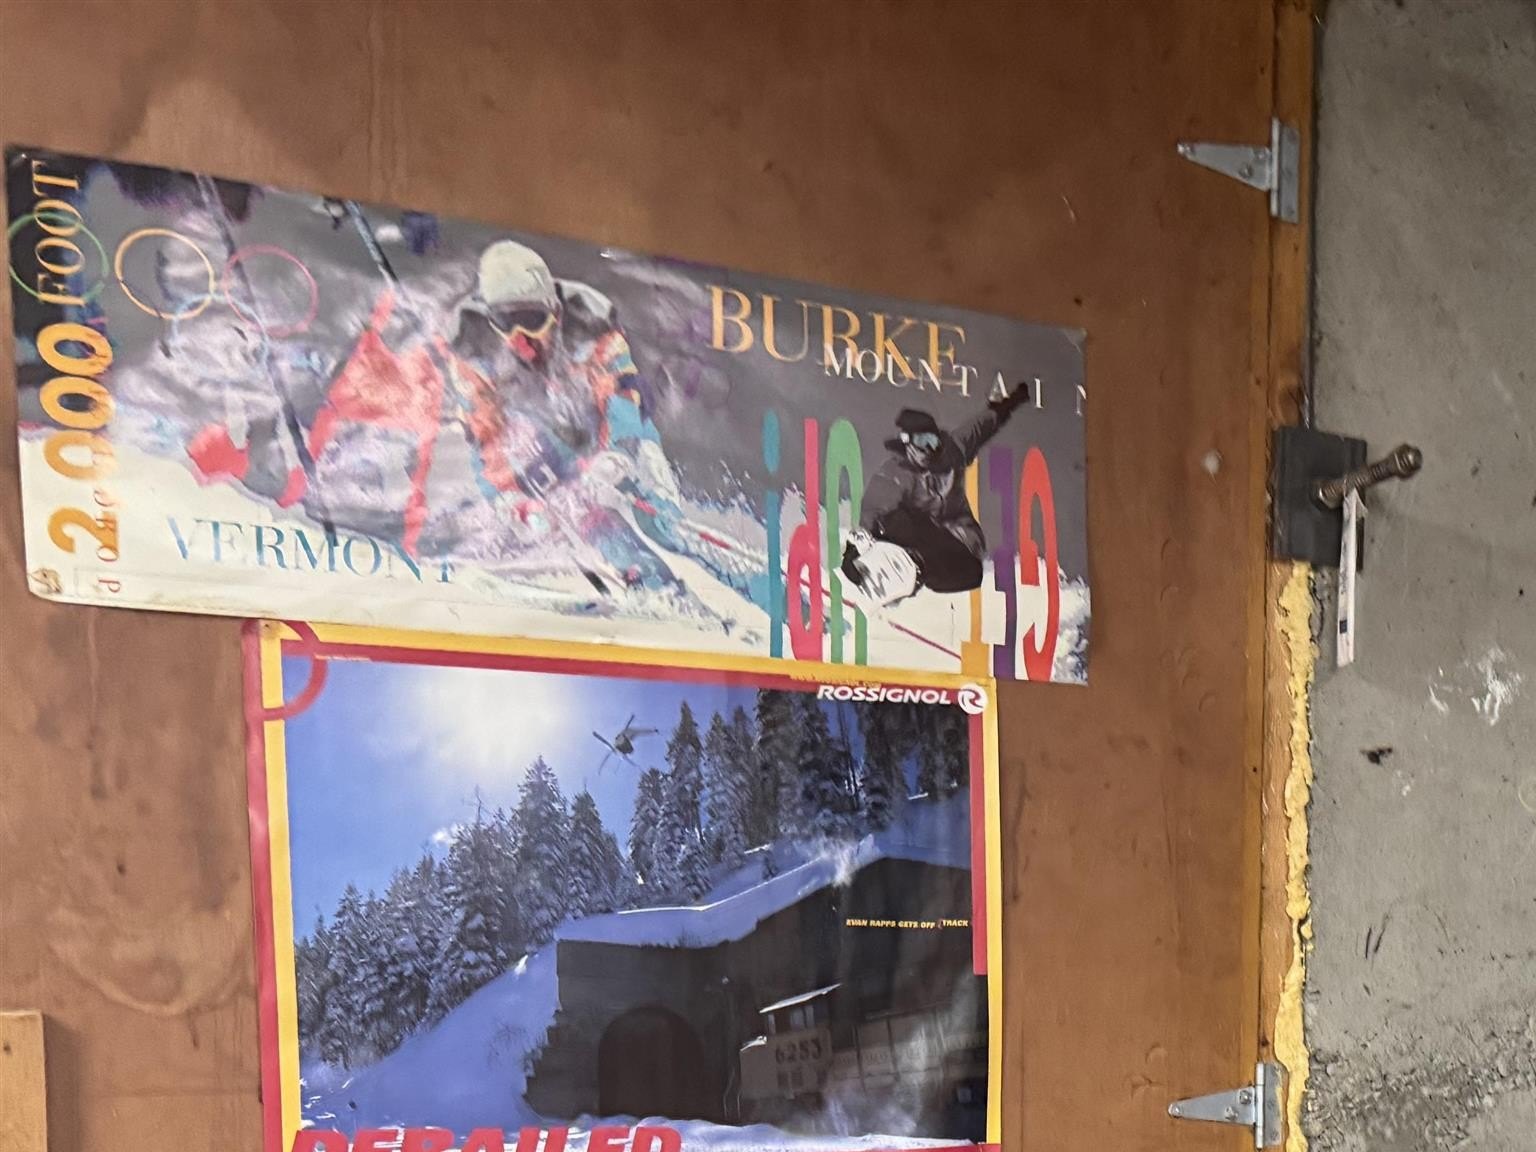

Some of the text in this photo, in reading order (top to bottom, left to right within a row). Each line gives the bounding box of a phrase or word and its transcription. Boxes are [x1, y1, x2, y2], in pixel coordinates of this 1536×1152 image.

[32, 159, 87, 307] FOOT
[705, 284, 967, 384] BURKE
[167, 515, 456, 584] VERMONT
[816, 684, 951, 705] ROSSIGNOL
[846, 918, 868, 927] EVAN
[898, 920, 919, 929] GETS
[920, 921, 936, 929] OFF
[942, 919, 969, 928] TRACK
